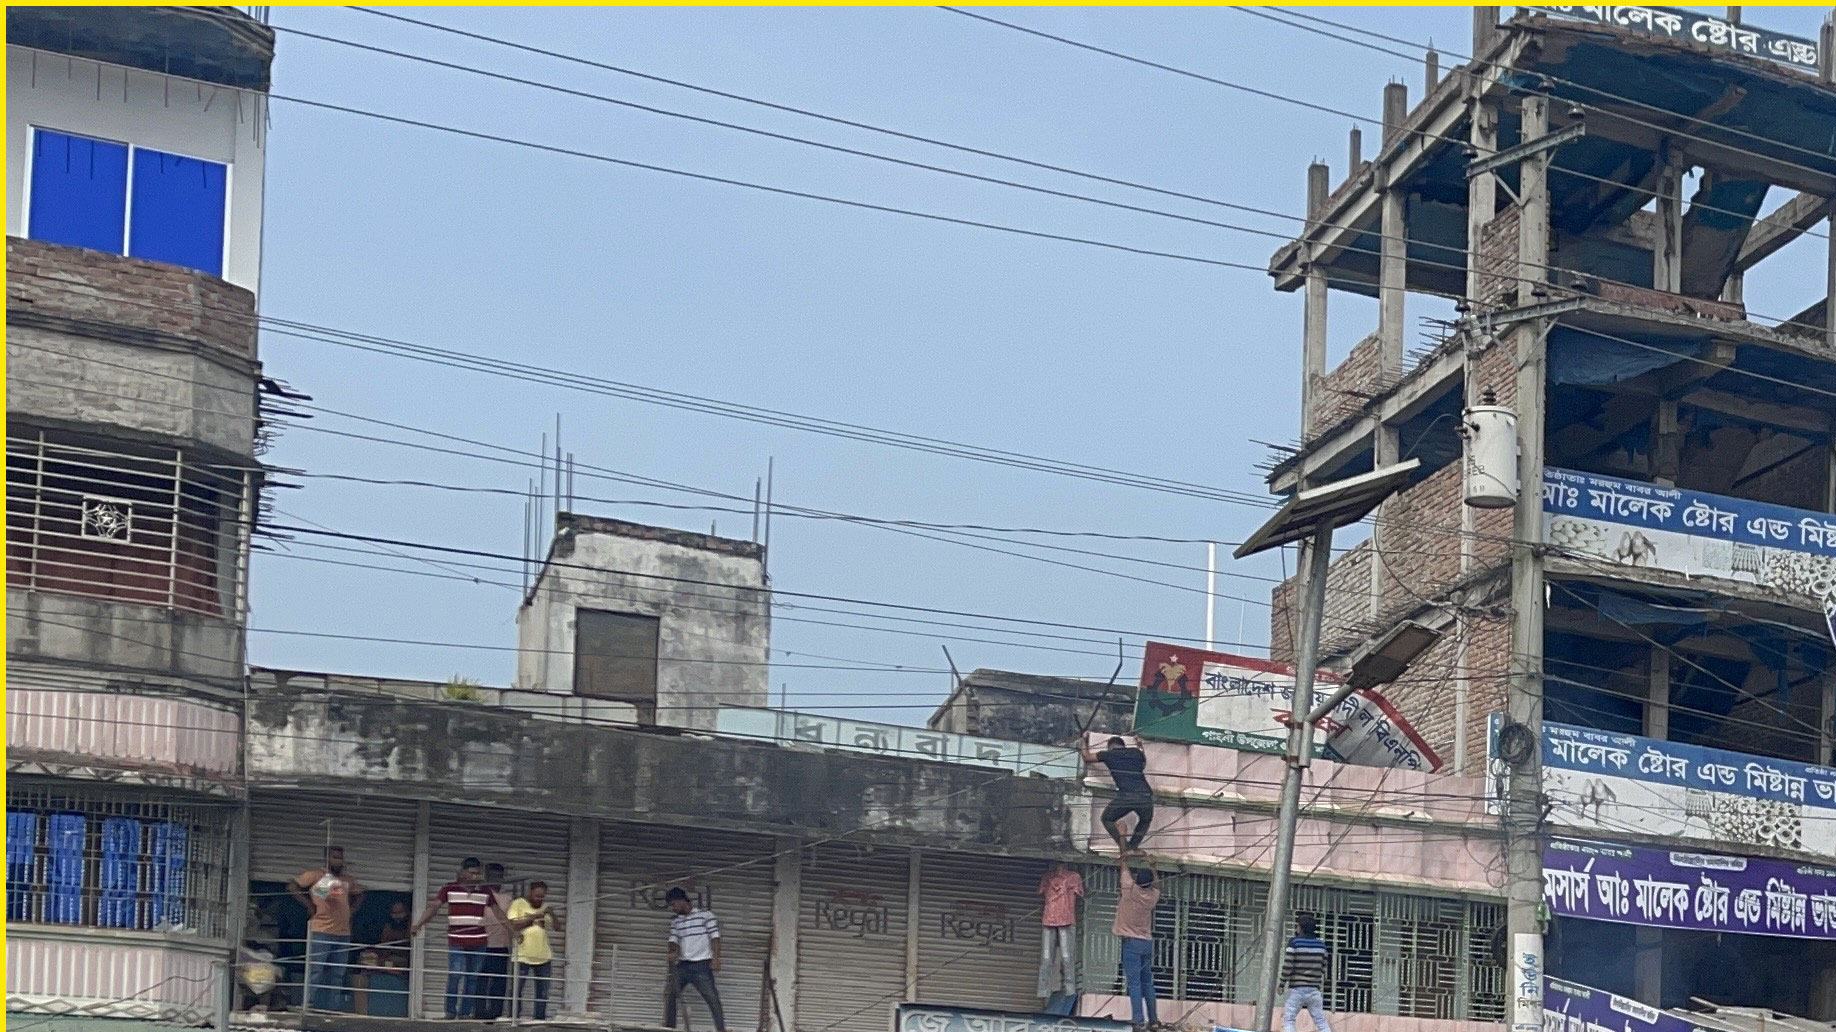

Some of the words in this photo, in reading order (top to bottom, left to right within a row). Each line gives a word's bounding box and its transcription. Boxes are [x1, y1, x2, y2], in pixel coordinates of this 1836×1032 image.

[1589, 489, 1675, 523] মালেক
[1683, 499, 1738, 535] ষ্টোর
[1747, 517, 1792, 540] এন্ড
[1205, 671, 1276, 701] বাংলাদেশ
[1548, 737, 1631, 770] মালেক
[1638, 748, 1689, 780] ষ্টোর
[1697, 763, 1738, 785] এন্ড
[1744, 763, 1808, 801] মিষ্টান্ন
[629, 880, 713, 912] Rel
[1542, 857, 1595, 914] মসার্স
[1596, 865, 1630, 916] আঃ
[1634, 874, 1690, 922] মালেক
[1734, 888, 1762, 927] এন্ড
[1766, 877, 1807, 934] মিষ্টান্ন
[815, 899, 889, 937] Regal
[940, 911, 1016, 946] Regal
